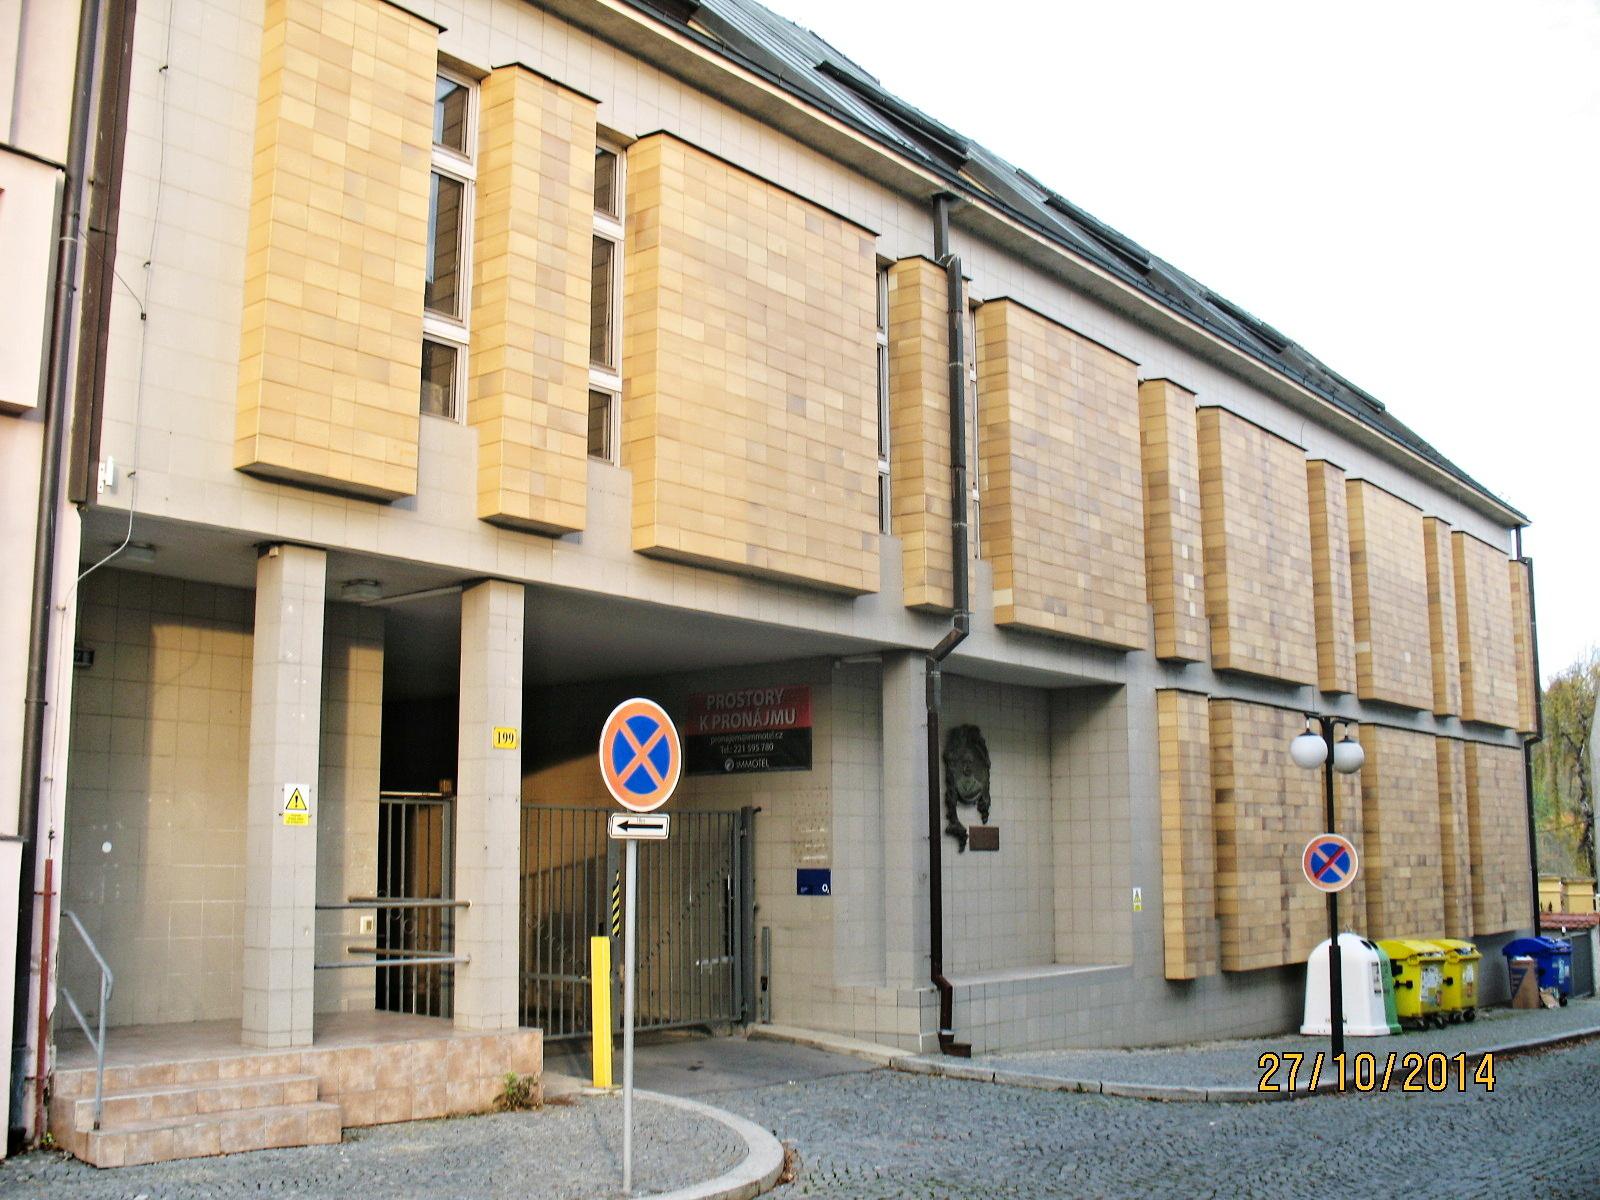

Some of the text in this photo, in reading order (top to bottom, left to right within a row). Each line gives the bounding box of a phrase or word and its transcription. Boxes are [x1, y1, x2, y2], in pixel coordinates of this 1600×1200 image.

[707, 688, 784, 709] PROSTORY
[700, 707, 796, 731] K PRONÁJMU
[497, 731, 514, 744] 199
